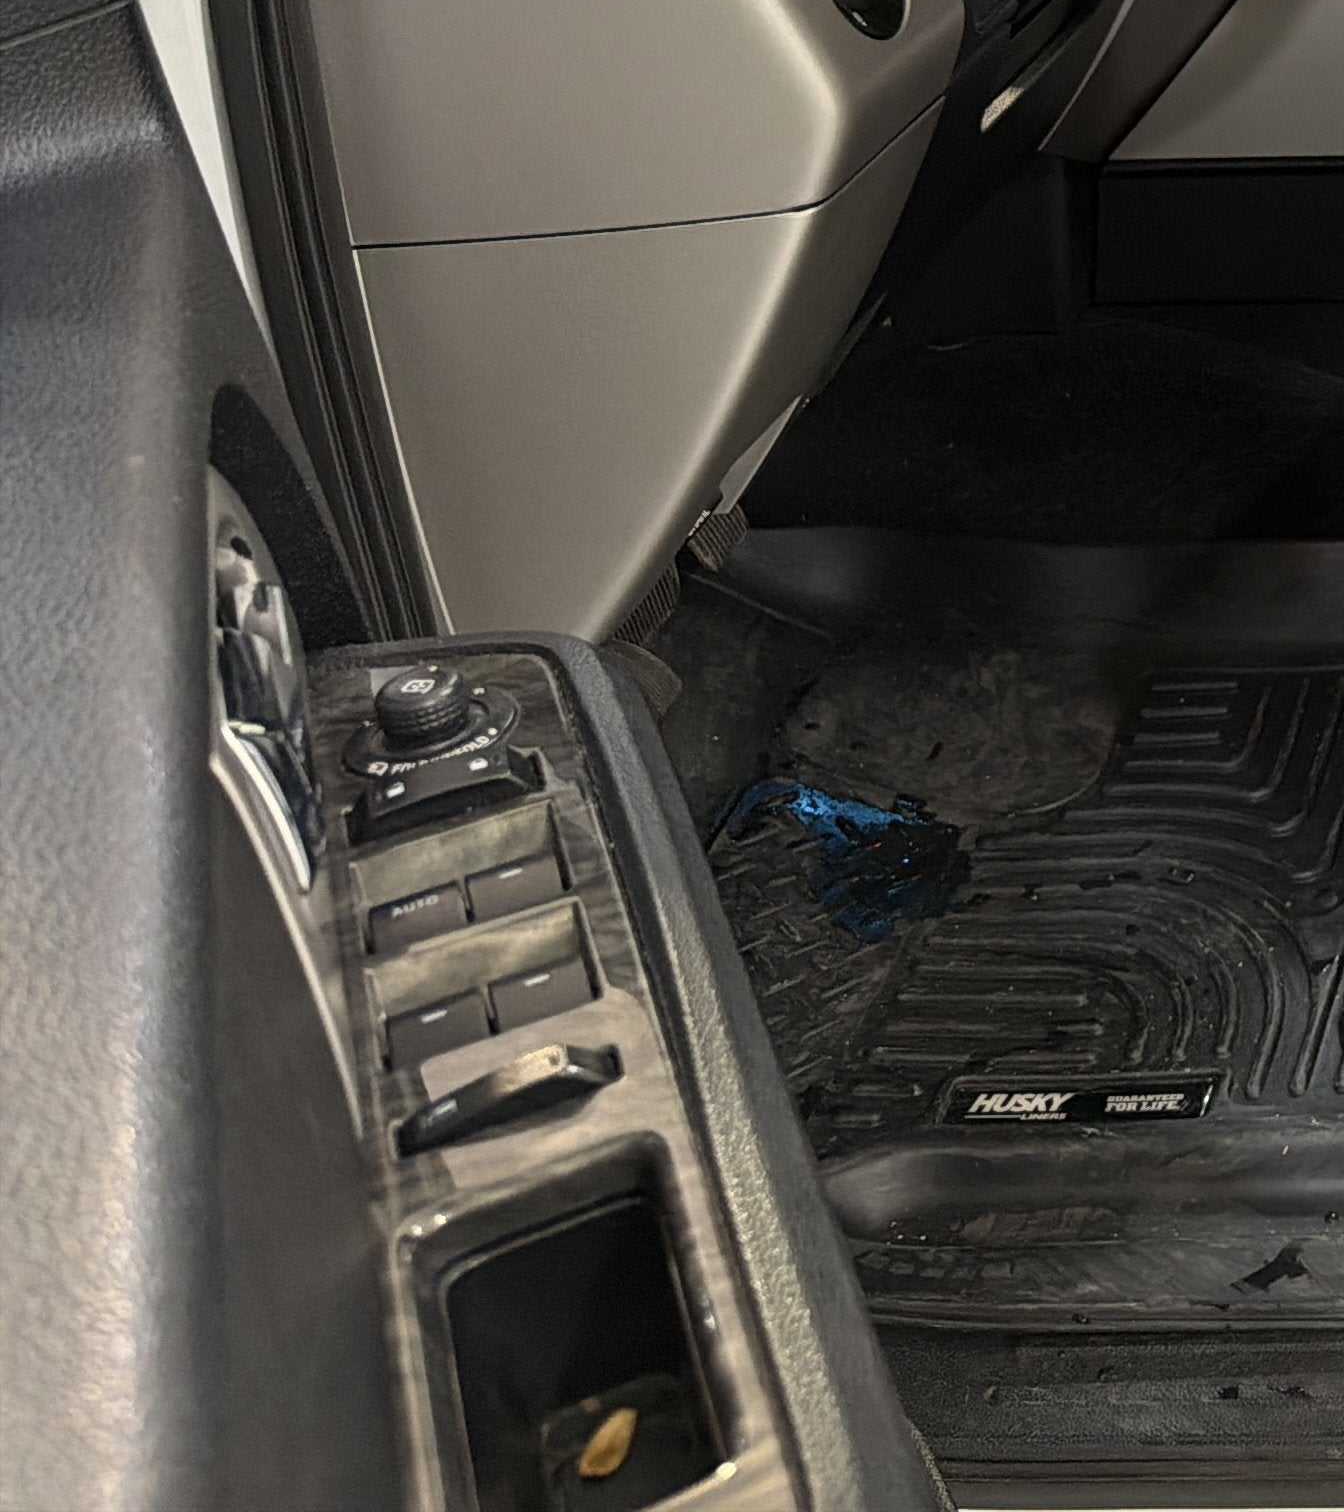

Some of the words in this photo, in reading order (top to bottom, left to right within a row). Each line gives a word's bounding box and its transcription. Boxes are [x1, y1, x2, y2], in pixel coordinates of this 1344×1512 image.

[1106, 1093, 1185, 1102] GUARANTEED
[968, 1092, 1076, 1113] HUSKY
[1104, 1102, 1138, 1112] FOR
[1020, 1112, 1067, 1121] LINERS
